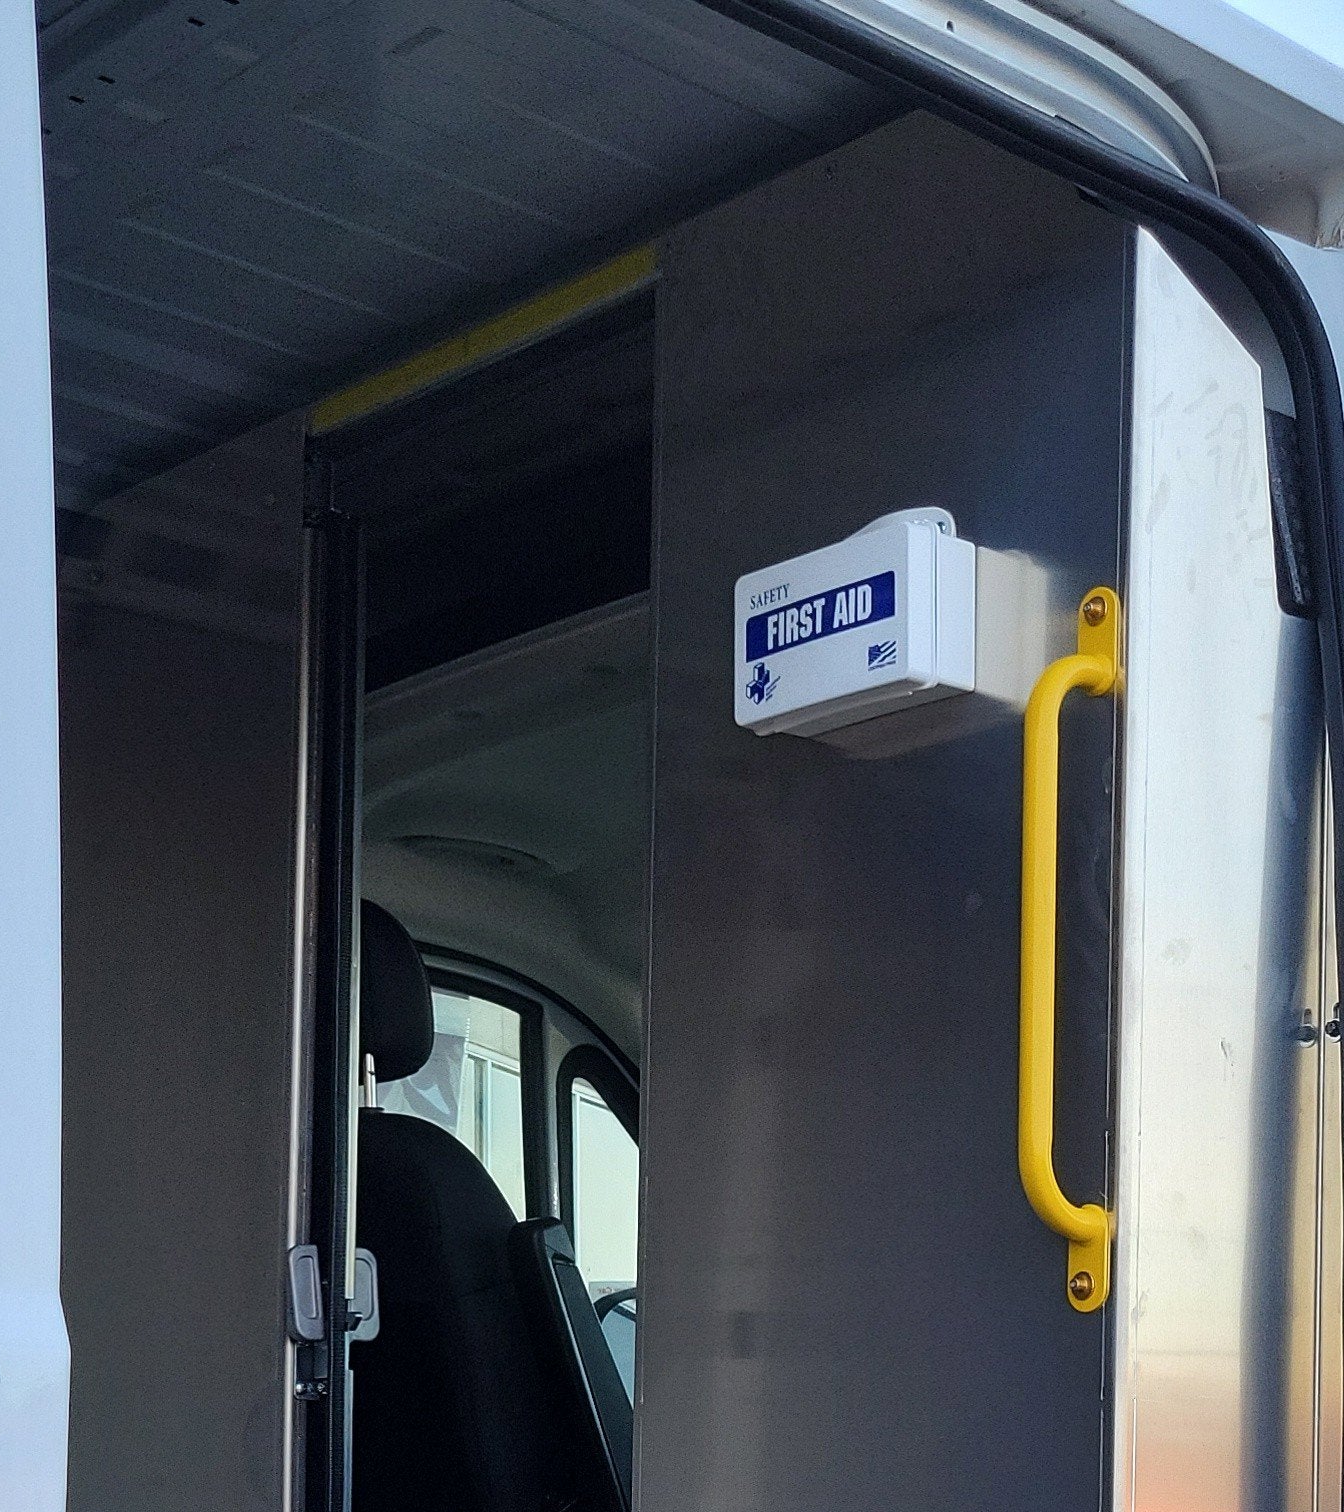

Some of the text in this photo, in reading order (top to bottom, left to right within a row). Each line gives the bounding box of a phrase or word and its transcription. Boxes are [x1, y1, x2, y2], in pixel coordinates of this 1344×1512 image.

[750, 583, 790, 610] SAFETY
[767, 583, 872, 650] FIRST AID
